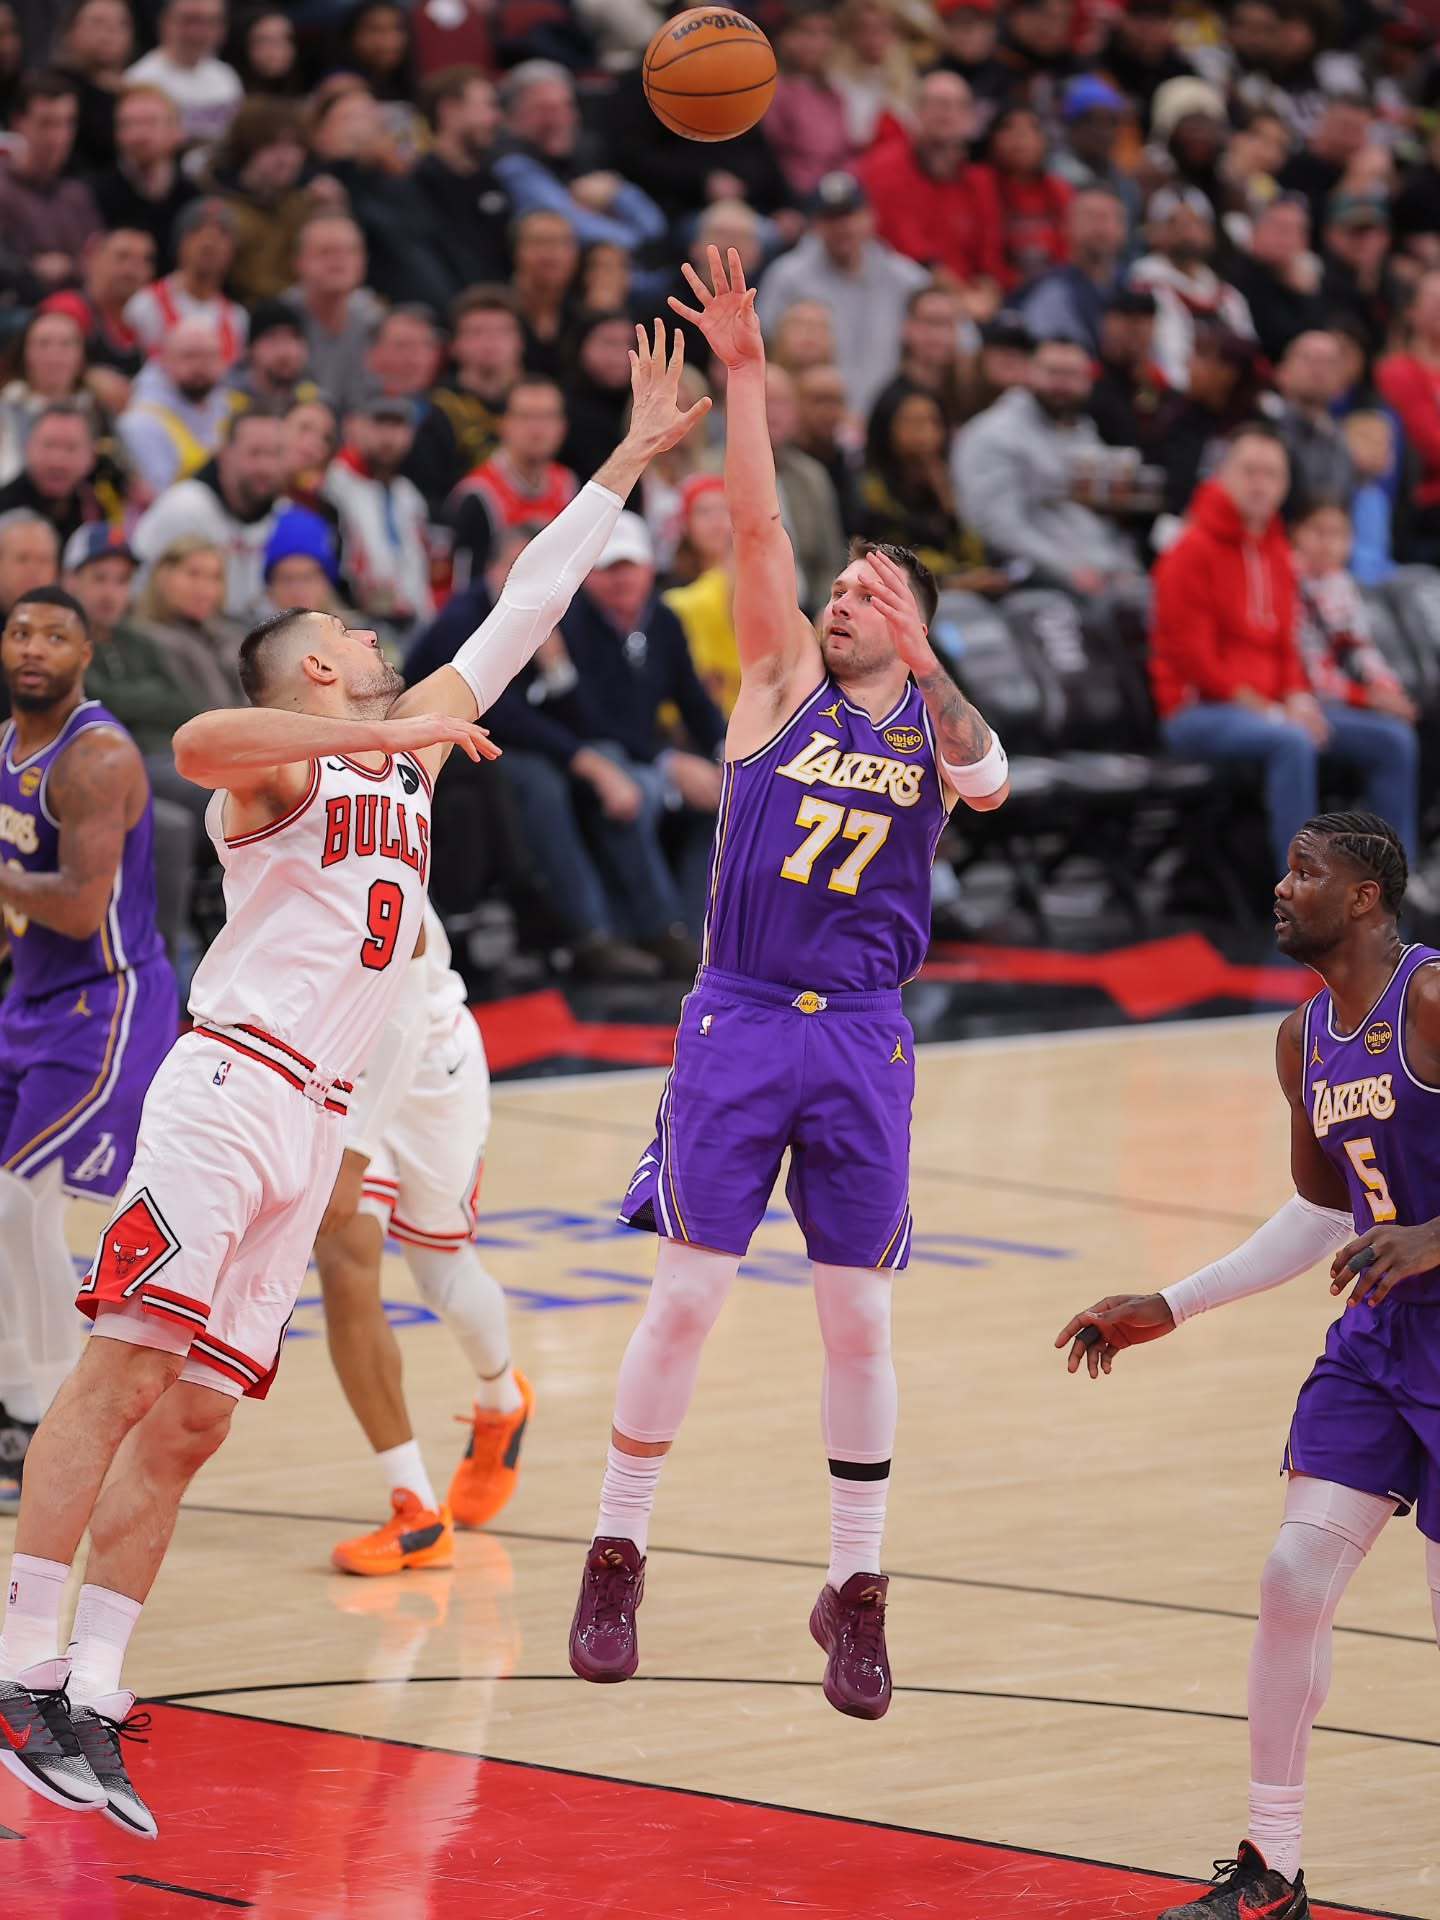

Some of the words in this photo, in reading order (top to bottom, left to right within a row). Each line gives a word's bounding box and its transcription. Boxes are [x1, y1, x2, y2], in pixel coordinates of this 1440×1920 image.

[775, 721, 926, 807] LAKERS
[886, 733, 921, 746] bibigo
[321, 795, 429, 887] BULLS
[780, 795, 893, 896] 77
[360, 878, 405, 972] 9
[1367, 1030, 1390, 1043] bibigo
[1312, 1074, 1396, 1138] LAKERS
[1344, 1137, 1397, 1223] 5
